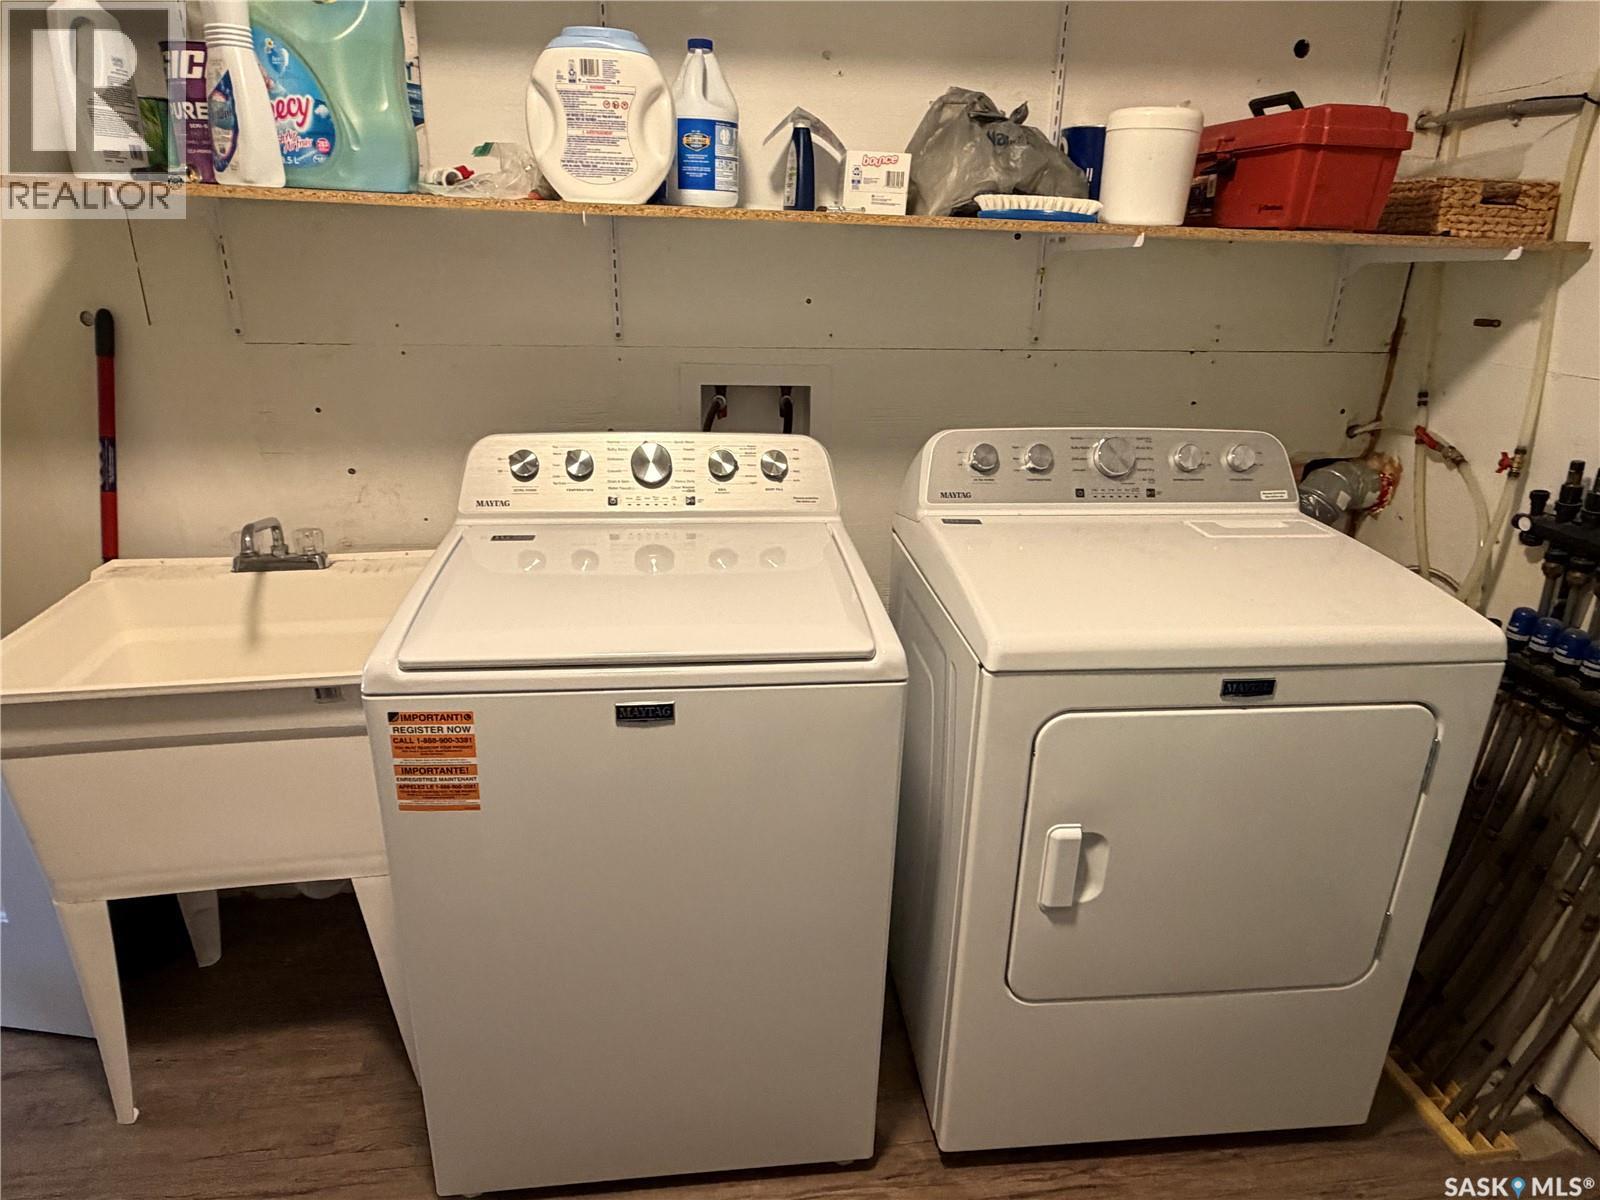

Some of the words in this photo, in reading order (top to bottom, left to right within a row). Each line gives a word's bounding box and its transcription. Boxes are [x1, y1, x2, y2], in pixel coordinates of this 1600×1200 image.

[862, 154, 899, 167] bounce
[619, 706, 672, 718] MAYTAG
[400, 714, 463, 722] IMPORTANT!
[393, 726, 444, 734] REGISTER
[447, 726, 472, 734] NOW
[401, 767, 469, 775] IMPORTANTE!
